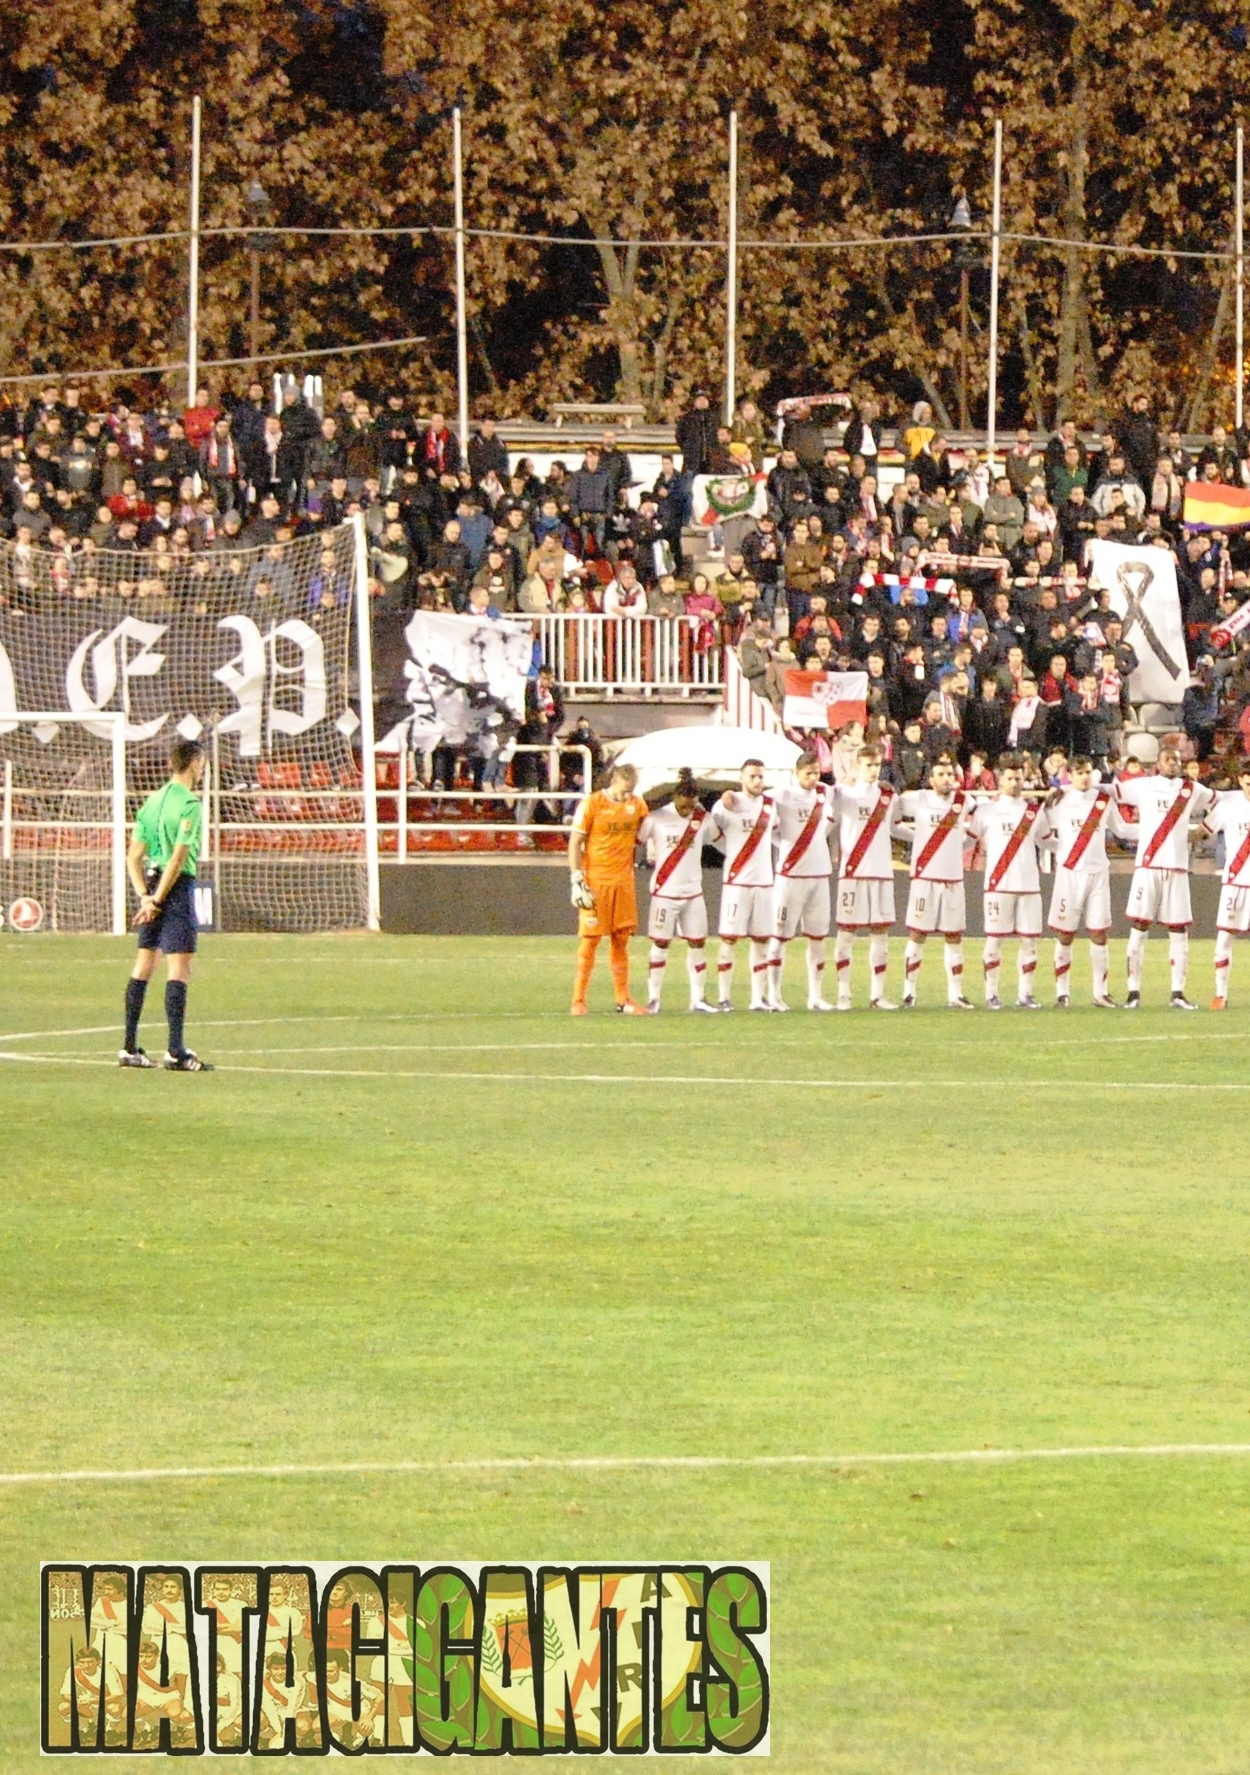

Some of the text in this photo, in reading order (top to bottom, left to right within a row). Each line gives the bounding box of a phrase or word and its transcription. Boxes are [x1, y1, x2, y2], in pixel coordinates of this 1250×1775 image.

[842, 891, 856, 908] 27
[915, 897, 926, 912] 10
[1059, 898, 1066, 913] 5
[1226, 897, 1238, 912] 21
[655, 908, 668, 923] 19
[727, 903, 739, 918] 17
[987, 901, 1000, 916] 24
